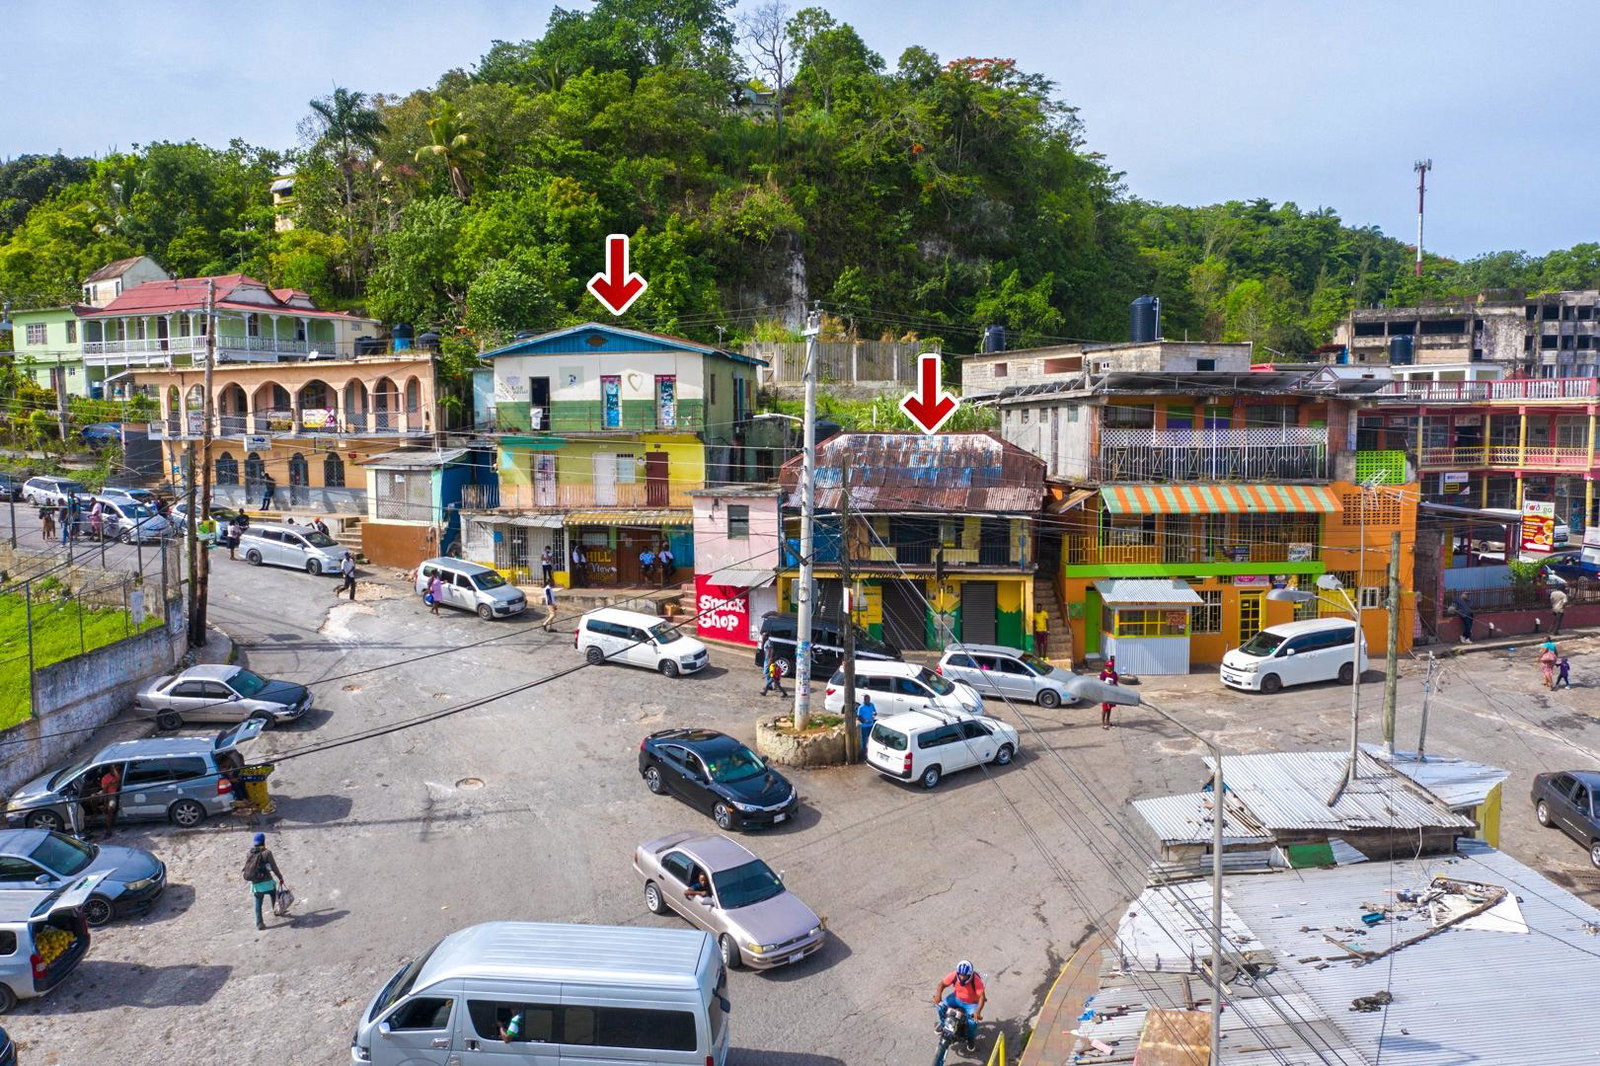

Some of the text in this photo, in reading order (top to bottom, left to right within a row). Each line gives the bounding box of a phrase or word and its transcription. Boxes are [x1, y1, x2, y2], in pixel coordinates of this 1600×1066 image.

[586, 551, 611, 562] HILL
[698, 595, 746, 613] Snack
[698, 610, 739, 631] Shop
